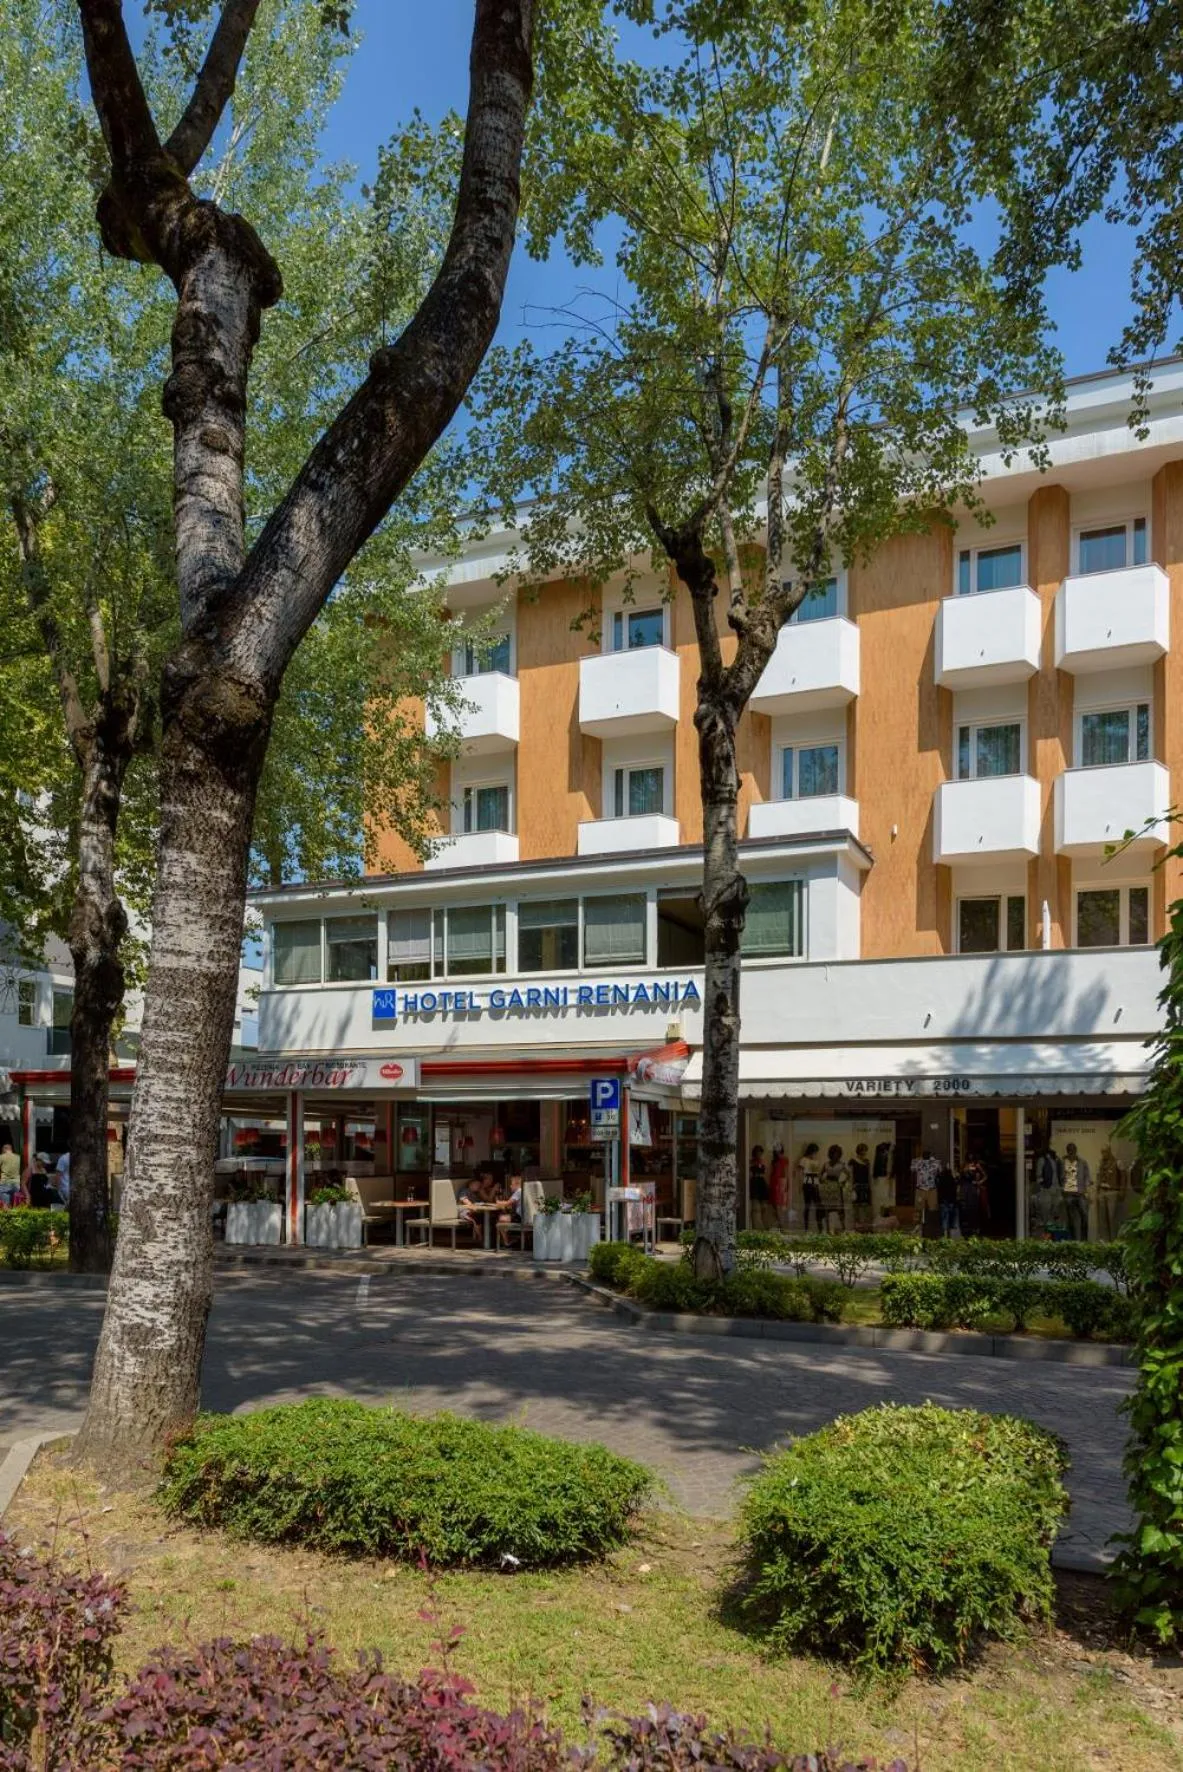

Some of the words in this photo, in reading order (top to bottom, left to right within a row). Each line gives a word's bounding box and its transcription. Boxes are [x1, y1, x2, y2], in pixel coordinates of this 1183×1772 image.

[403, 992, 481, 1012] HOTEL
[489, 986, 568, 1008] GARNI
[578, 980, 700, 1005] RENANIA
[596, 1082, 614, 1107] P
[845, 1079, 915, 1092] VARIETY
[934, 1078, 970, 1091] 2000
